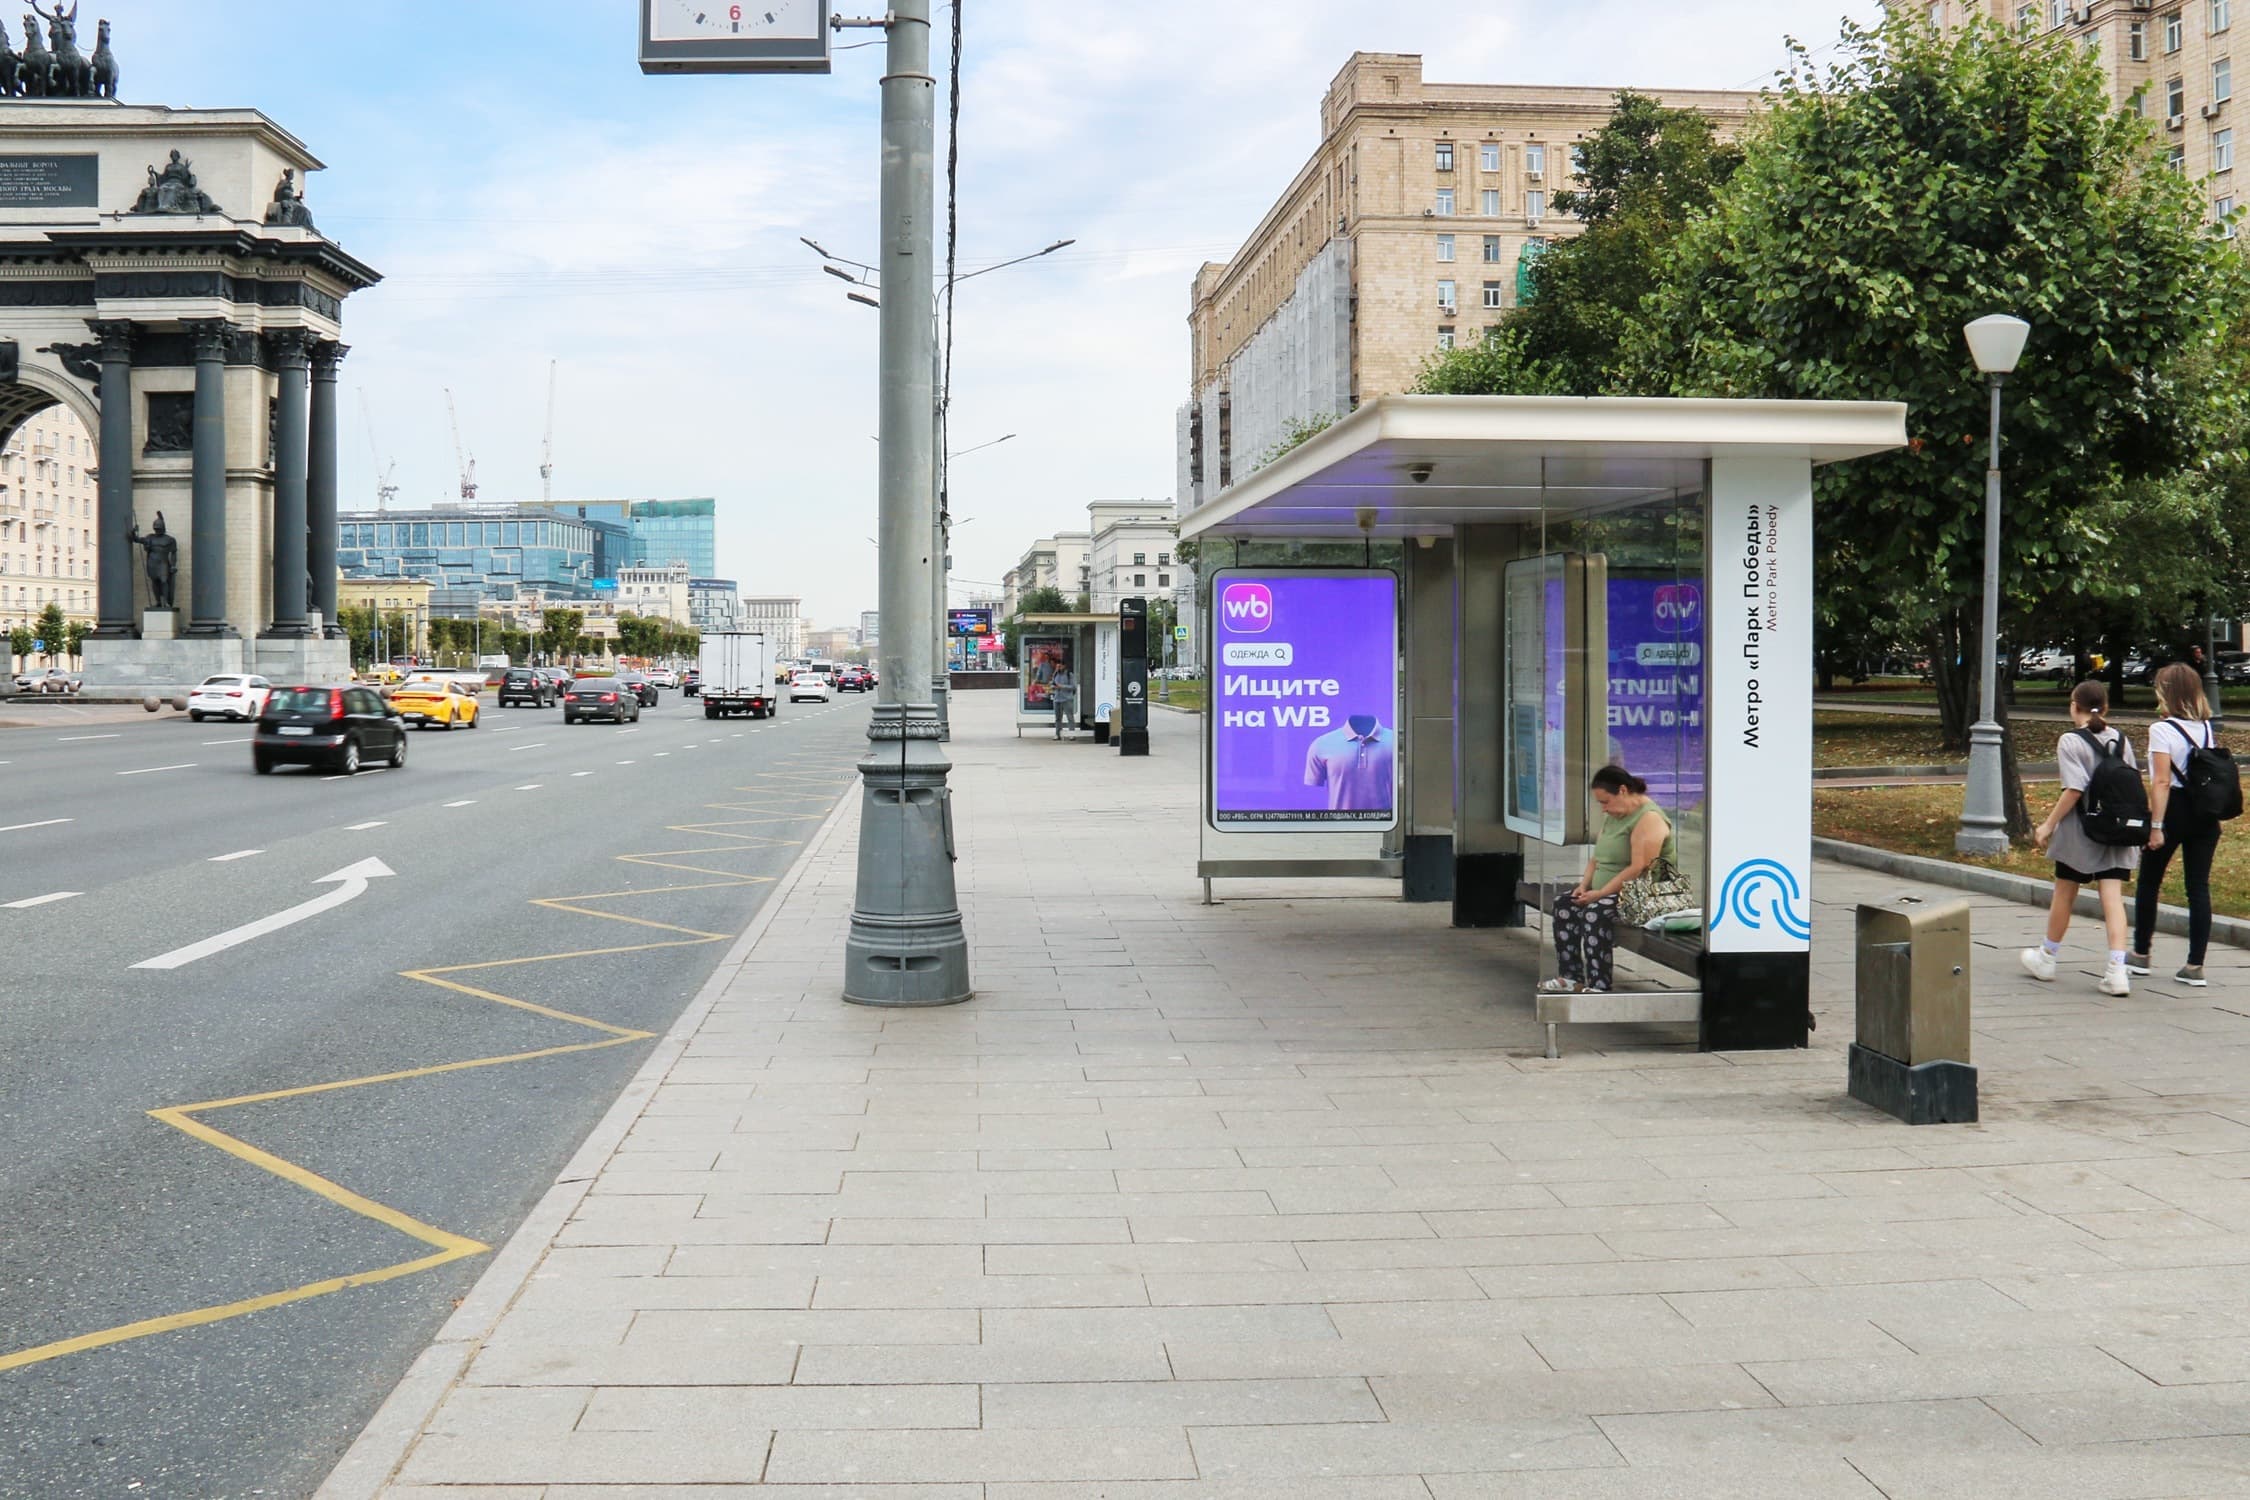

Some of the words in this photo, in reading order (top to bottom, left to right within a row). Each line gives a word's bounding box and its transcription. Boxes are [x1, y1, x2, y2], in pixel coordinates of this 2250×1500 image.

[730, 5, 741, 20] 6
[1766, 504, 1780, 554] Pobedy
[1743, 504, 1762, 598] Победы»
[1766, 557, 1777, 587] Park
[1226, 594, 1268, 618] wb
[1766, 591, 1777, 632] Metro
[1743, 606, 1763, 671] «Парк
[1230, 650, 1270, 660] ОДЕЖДА
[1224, 675, 1340, 700] Ищите
[1224, 710, 1266, 727] на
[1272, 706, 1331, 727] WB
[1743, 679, 1763, 749] Метро
